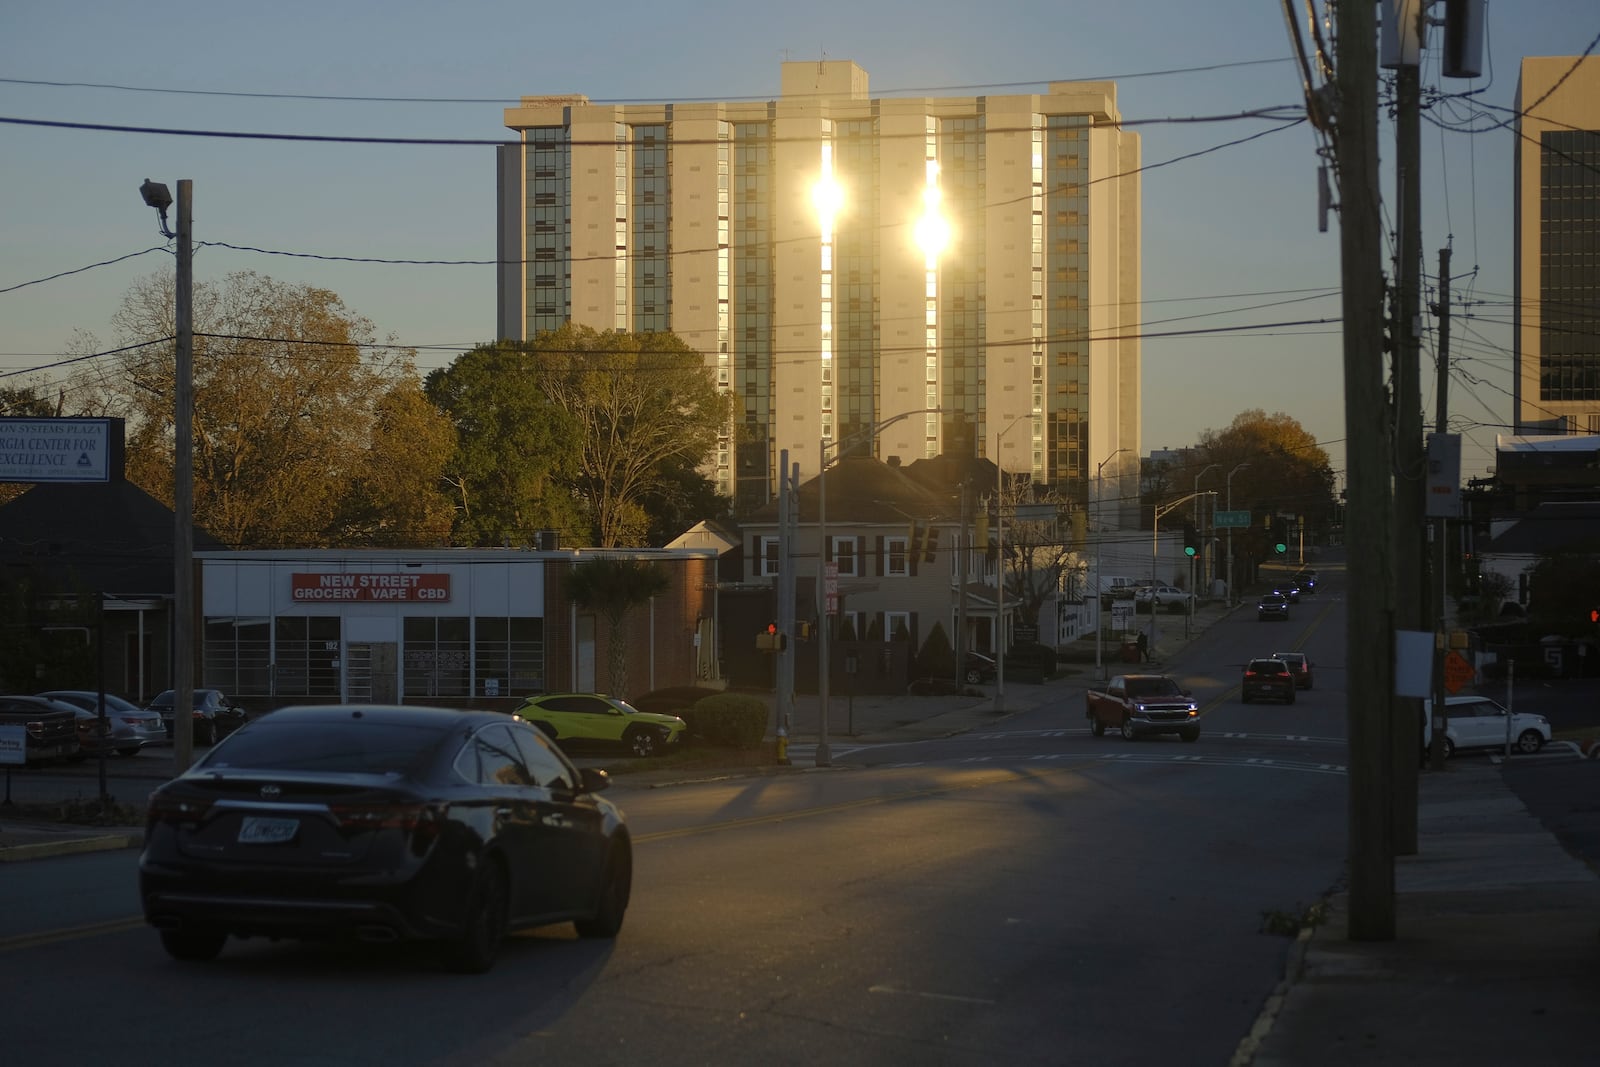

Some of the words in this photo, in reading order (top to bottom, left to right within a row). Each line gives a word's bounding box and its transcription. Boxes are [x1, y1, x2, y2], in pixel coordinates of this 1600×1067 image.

[18, 425, 64, 434] SYSTEMS
[66, 425, 102, 434] PLAZA
[28, 438, 71, 451] CENTER
[73, 439, 96, 451] FOR
[1216, 515, 1234, 523] New
[319, 575, 355, 587] NEW
[359, 575, 420, 587] STREET
[294, 588, 360, 599] GROCERY
[370, 588, 407, 599] VAPE
[417, 588, 447, 599] CBD
[325, 641, 338, 650] 192
